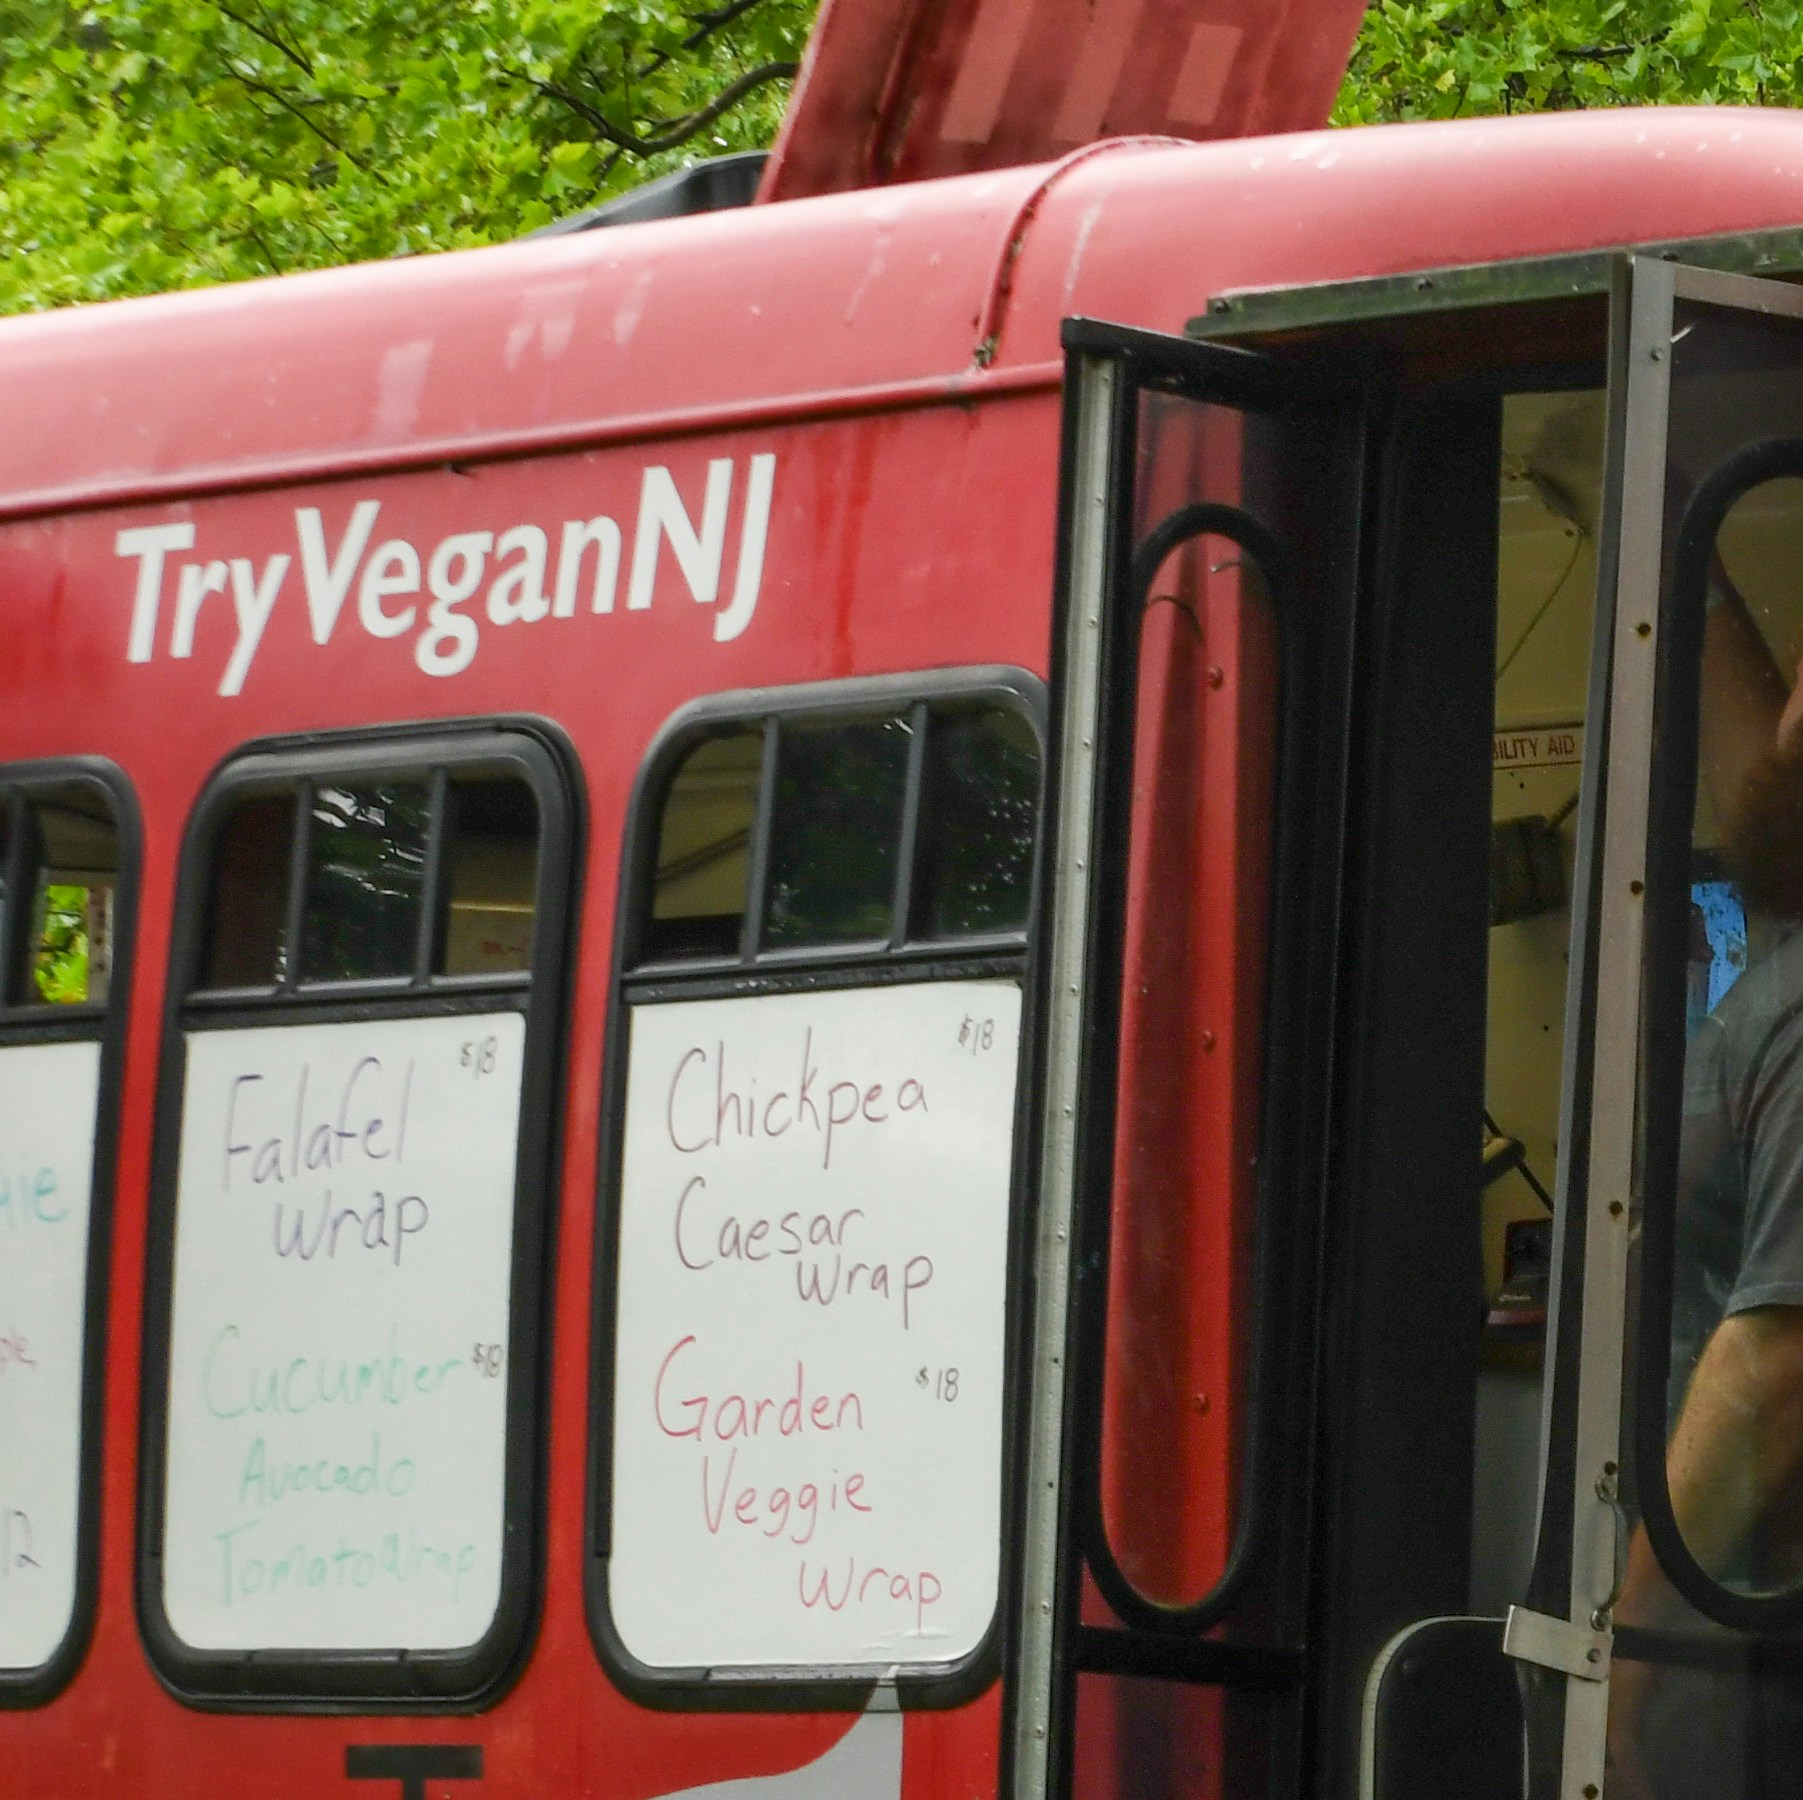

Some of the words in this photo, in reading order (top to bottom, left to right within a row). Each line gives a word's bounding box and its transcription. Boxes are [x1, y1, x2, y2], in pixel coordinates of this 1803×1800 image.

[114, 453, 776, 697] TryVeganNJ
[1492, 737, 1538, 760] ILITY
[1547, 734, 1576, 756] AID
[222, 1056, 415, 1191] Falafel
[667, 1025, 929, 1170] Chickpea
[673, 1175, 866, 1271] Caesar
[655, 1335, 863, 1442] Garden
[915, 1366, 961, 1403] $18
[238, 1429, 416, 1507] Avocado
[703, 1447, 873, 1545] Veggie
